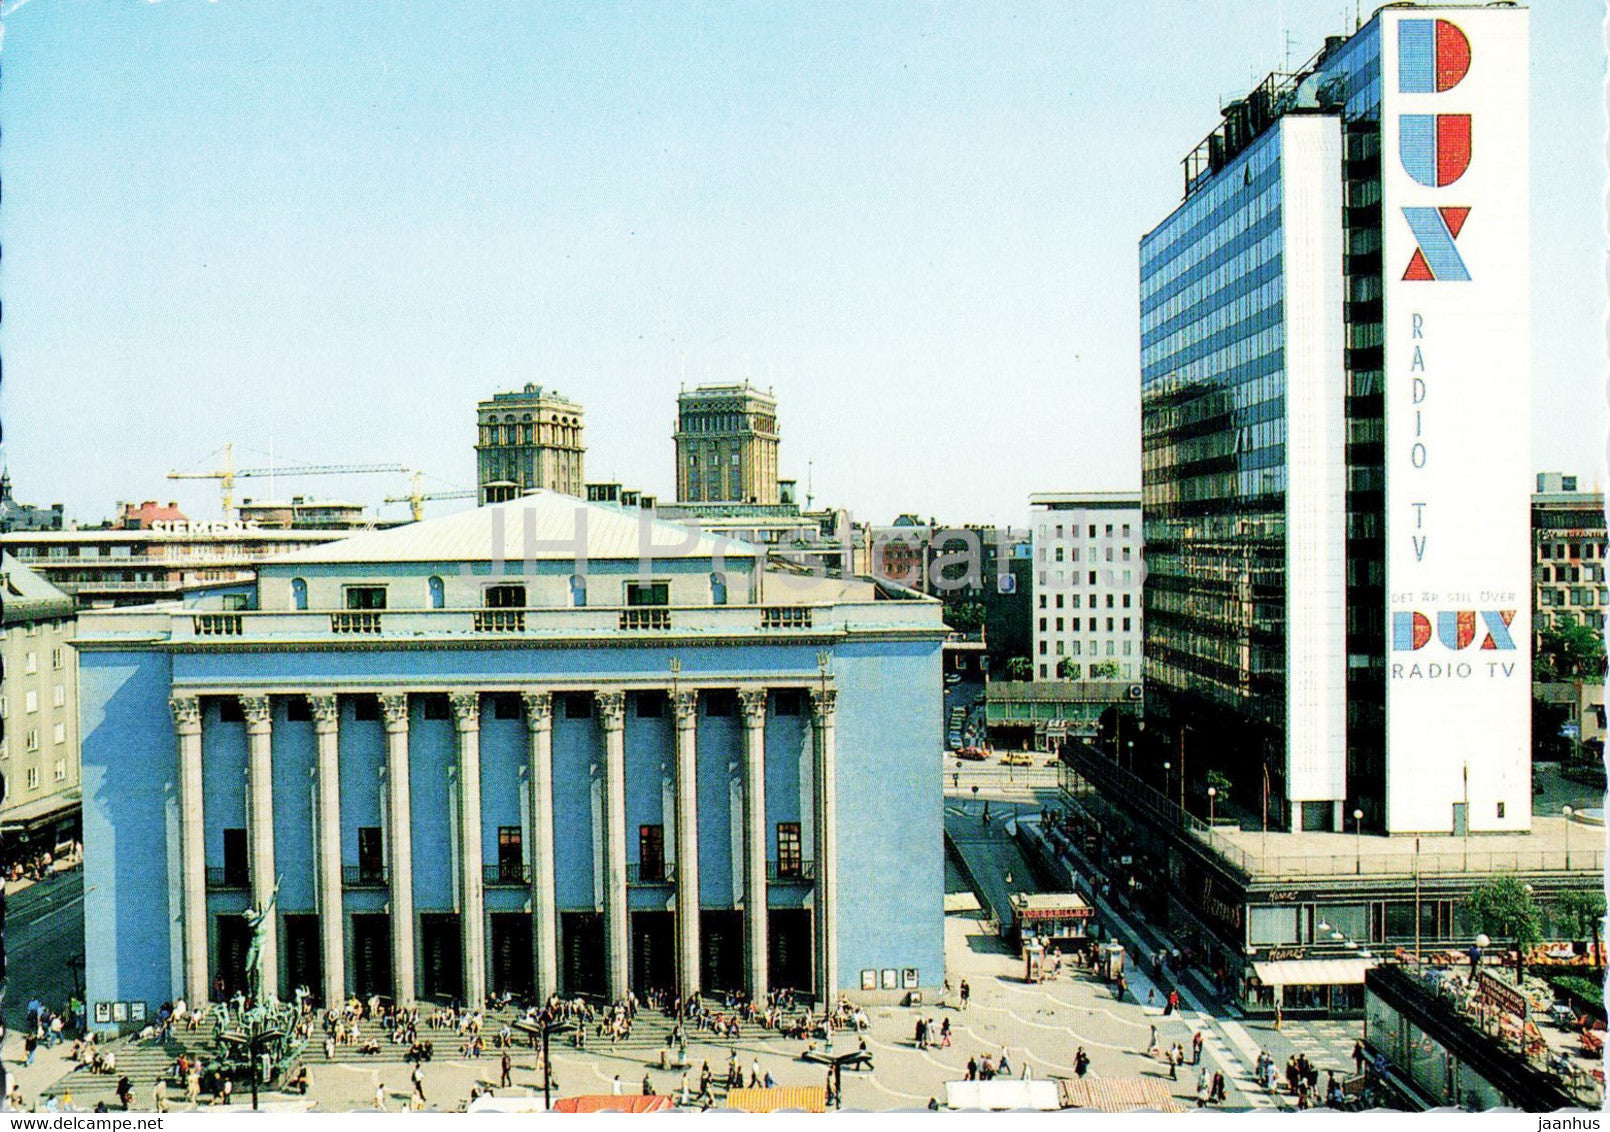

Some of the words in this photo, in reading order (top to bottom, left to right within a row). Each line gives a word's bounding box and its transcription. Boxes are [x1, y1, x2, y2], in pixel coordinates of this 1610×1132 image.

[1398, 18, 1473, 282] DUX
[1411, 312, 1427, 469] RADIO
[151, 519, 261, 535] SIEMENS
[1411, 502, 1427, 562] TV
[1392, 592, 1414, 603] DET
[1393, 609, 1517, 651] DUX
[1392, 662, 1472, 678] RADIO
[1486, 662, 1515, 678] TV
